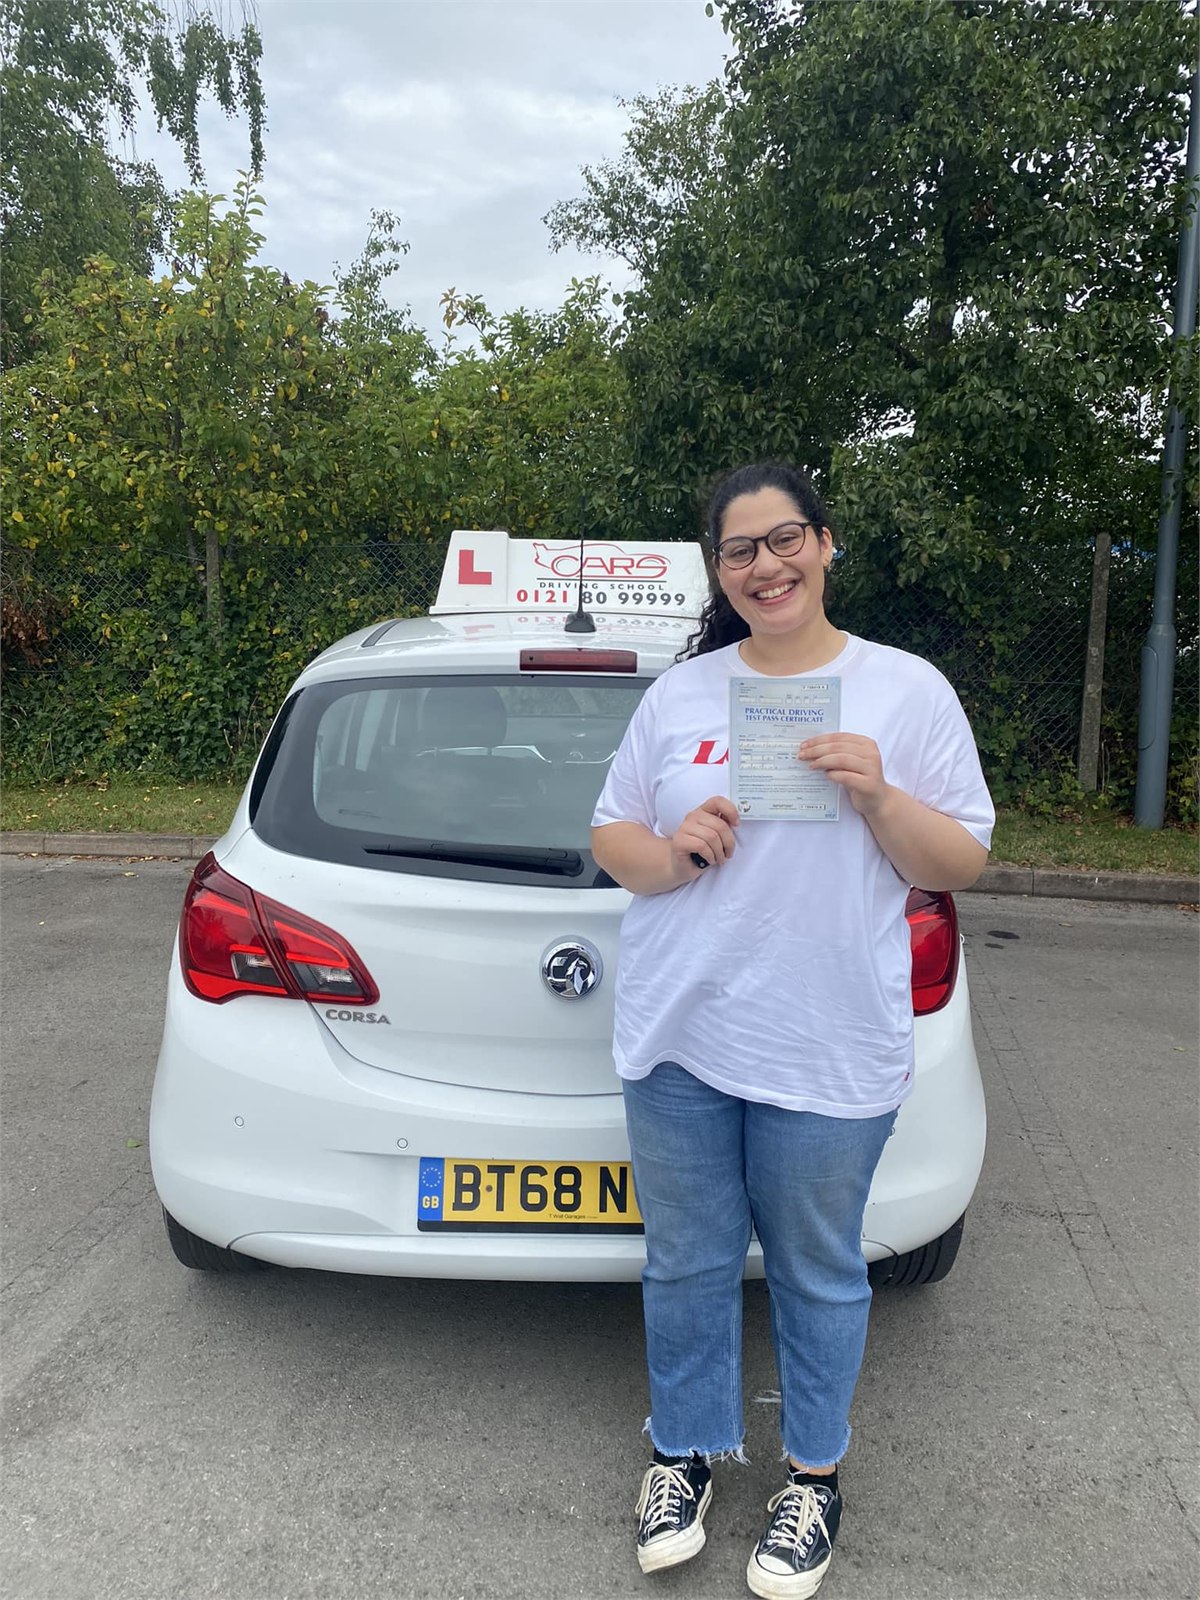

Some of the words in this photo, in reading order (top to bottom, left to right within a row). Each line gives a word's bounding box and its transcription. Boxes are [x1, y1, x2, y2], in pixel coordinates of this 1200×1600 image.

[458, 549, 492, 584] L
[550, 555, 668, 578] CARS
[539, 581, 599, 590] DRIVING
[609, 583, 665, 591] SCHOOL
[516, 589, 569, 604] 0121
[581, 591, 608, 605] 80
[617, 592, 686, 606] 99999
[745, 707, 786, 716] PRACTICAL
[788, 708, 824, 716] DRIVING
[780, 715, 824, 723] CERTIFICATE
[690, 740, 729, 764] L
[325, 1008, 392, 1025] CORSA
[452, 1164, 582, 1212] BT68
[422, 1196, 440, 1209] GB
